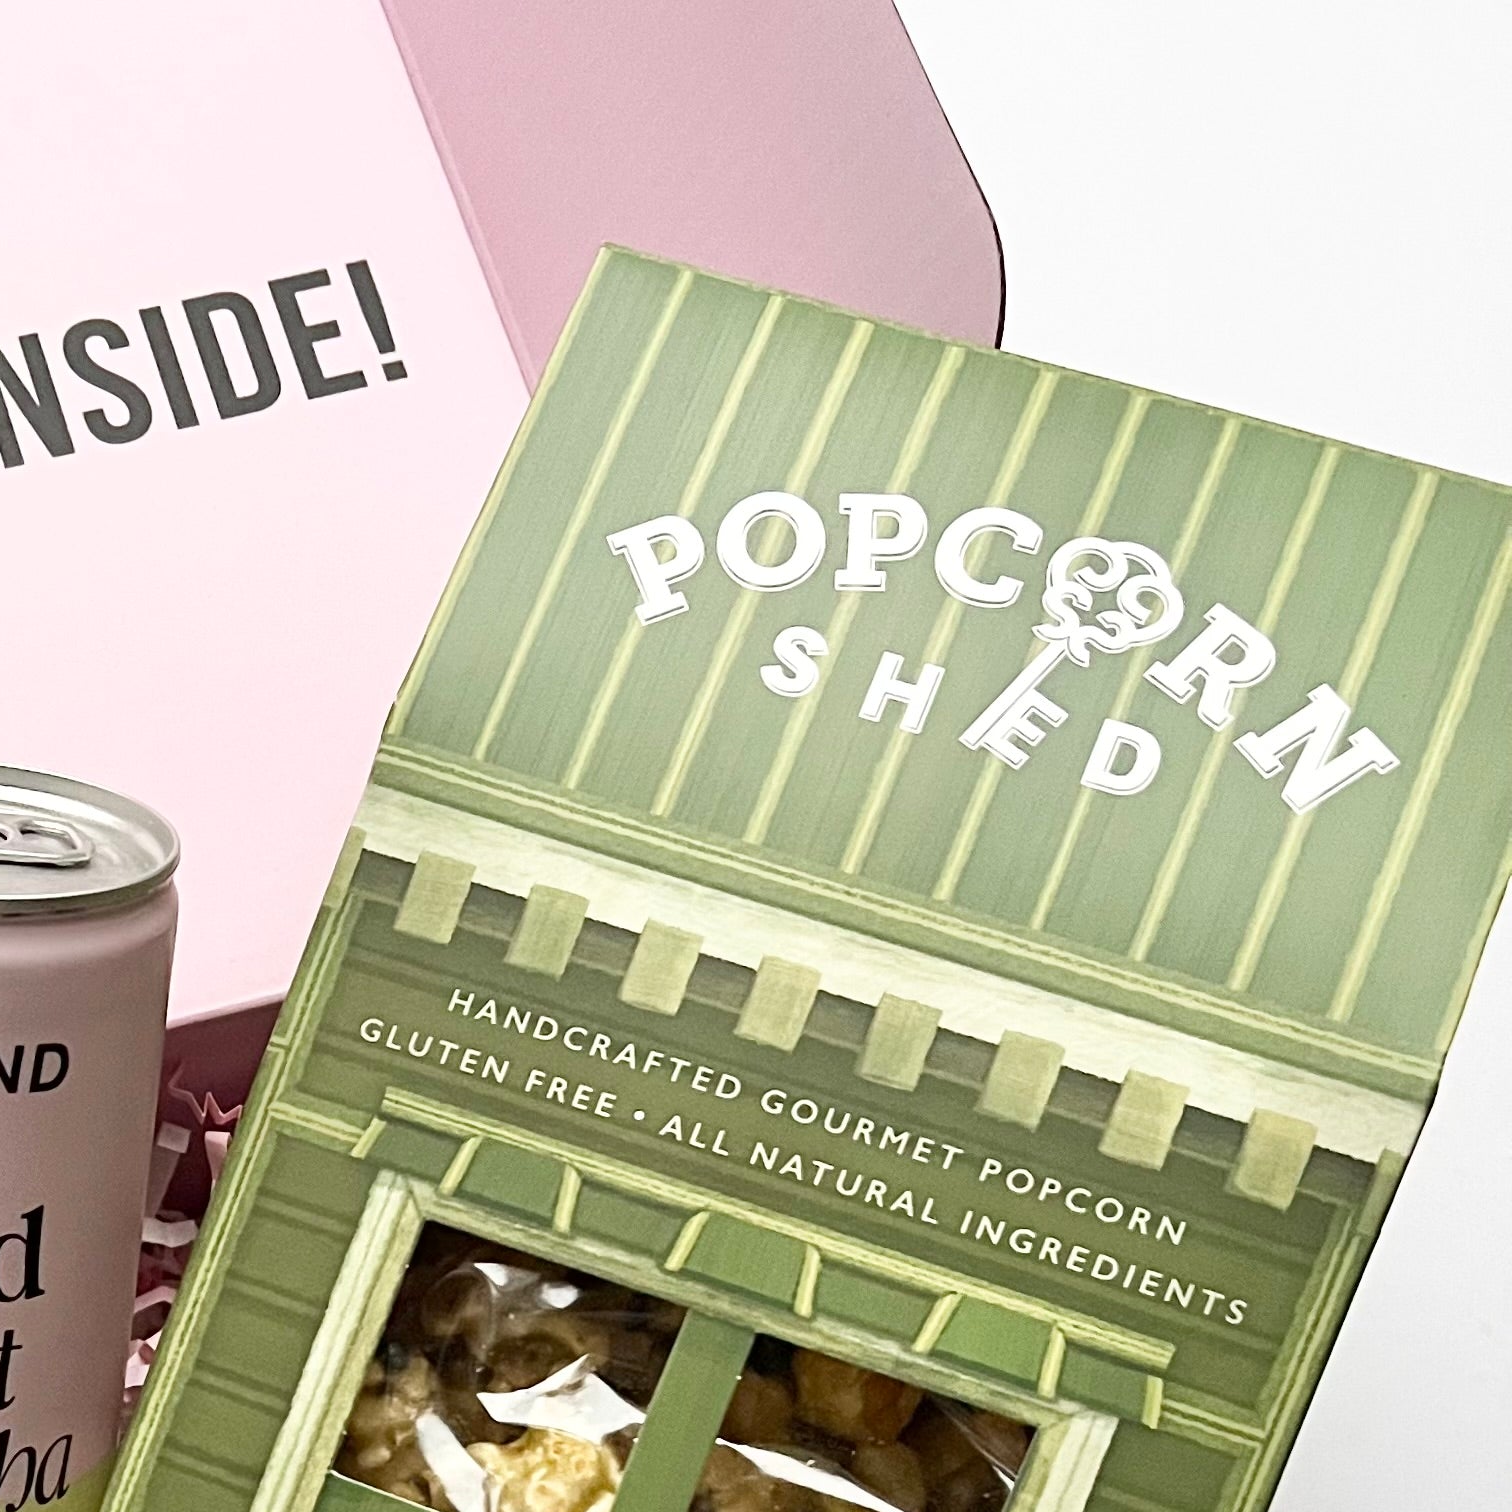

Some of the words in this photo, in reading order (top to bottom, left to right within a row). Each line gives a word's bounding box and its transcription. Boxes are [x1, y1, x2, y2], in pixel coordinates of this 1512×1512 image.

[606, 489, 1400, 816] POPCORN
[759, 624, 1161, 797] SHED
[359, 1018, 511, 1084] GLUTEN
[524, 1069, 618, 1118] FREE
[659, 1114, 730, 1157] ALL
[750, 1141, 939, 1224] NATURAL
[960, 1210, 1248, 1326] INGREDIENTS
[447, 987, 742, 1100] HANDCRAFTED
[761, 1089, 963, 1170] GOURMET
[978, 1157, 1187, 1245] POPCORN
